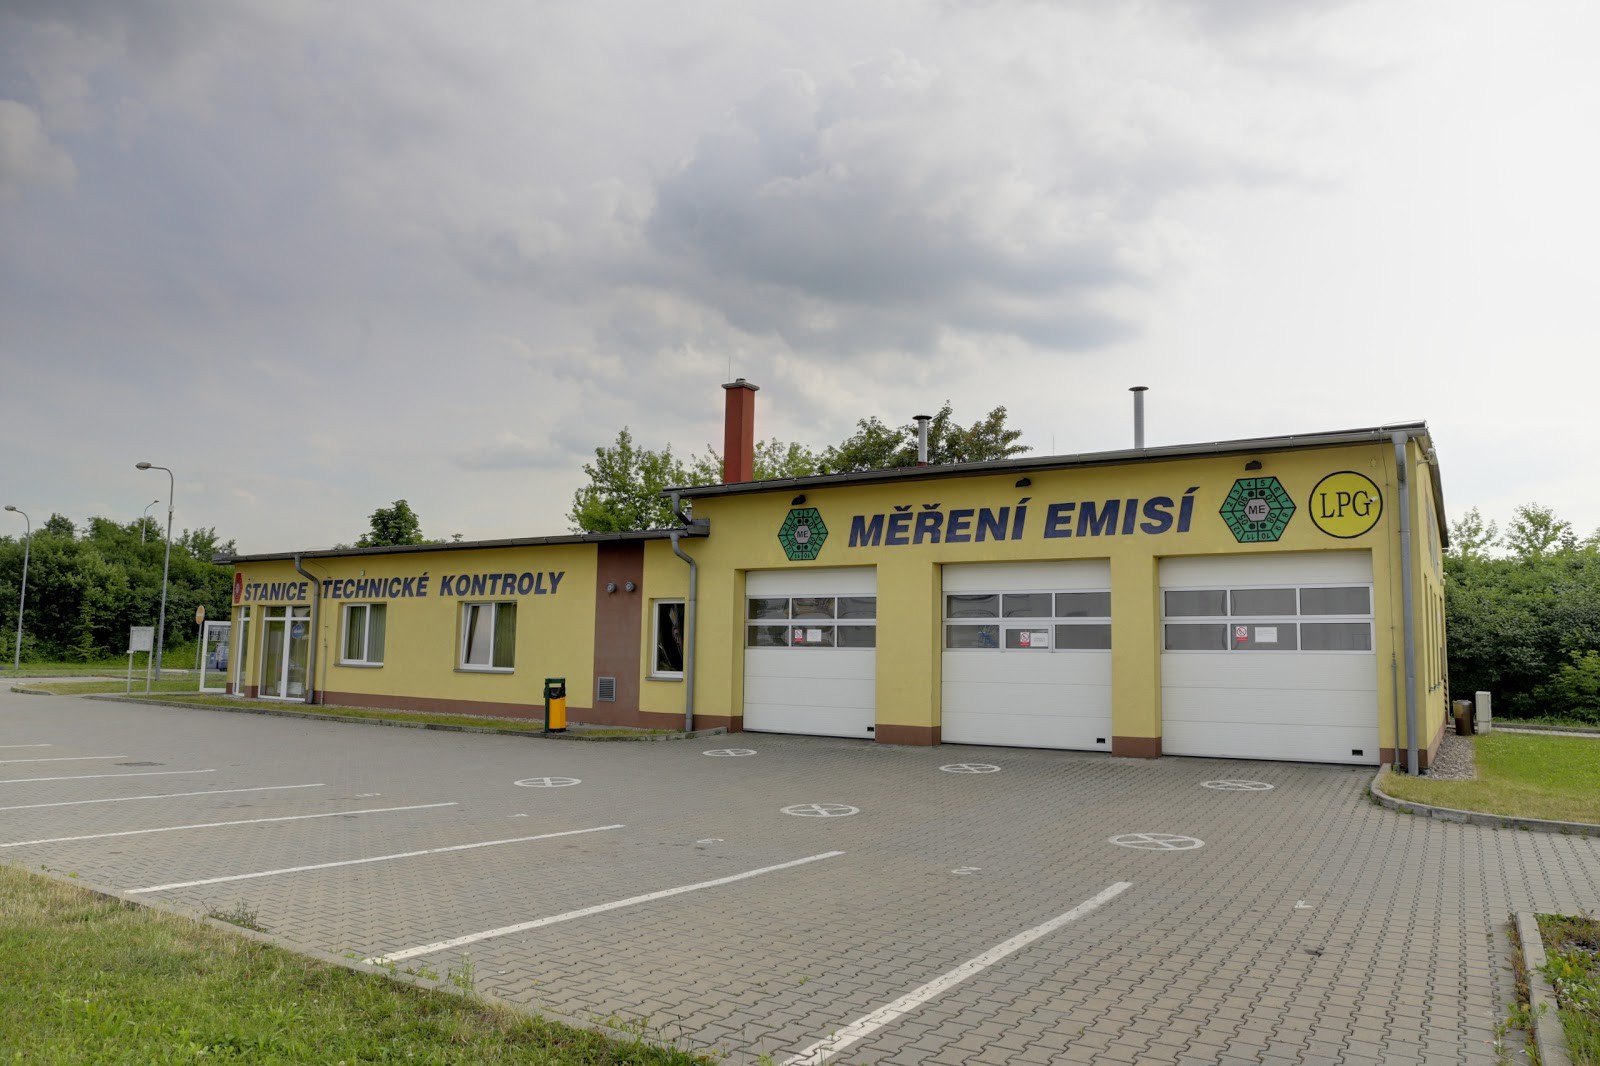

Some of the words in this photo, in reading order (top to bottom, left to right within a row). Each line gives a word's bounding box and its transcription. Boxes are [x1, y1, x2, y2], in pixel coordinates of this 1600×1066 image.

[848, 497, 1032, 547] MĚŘENÍ
[1043, 486, 1200, 539] EMISÍ
[1249, 505, 1265, 514] ME
[1320, 490, 1371, 518] LPG
[244, 581, 309, 601] STANICE
[322, 571, 430, 599] TECHNICKÉ
[439, 571, 566, 597] KONTROLY
